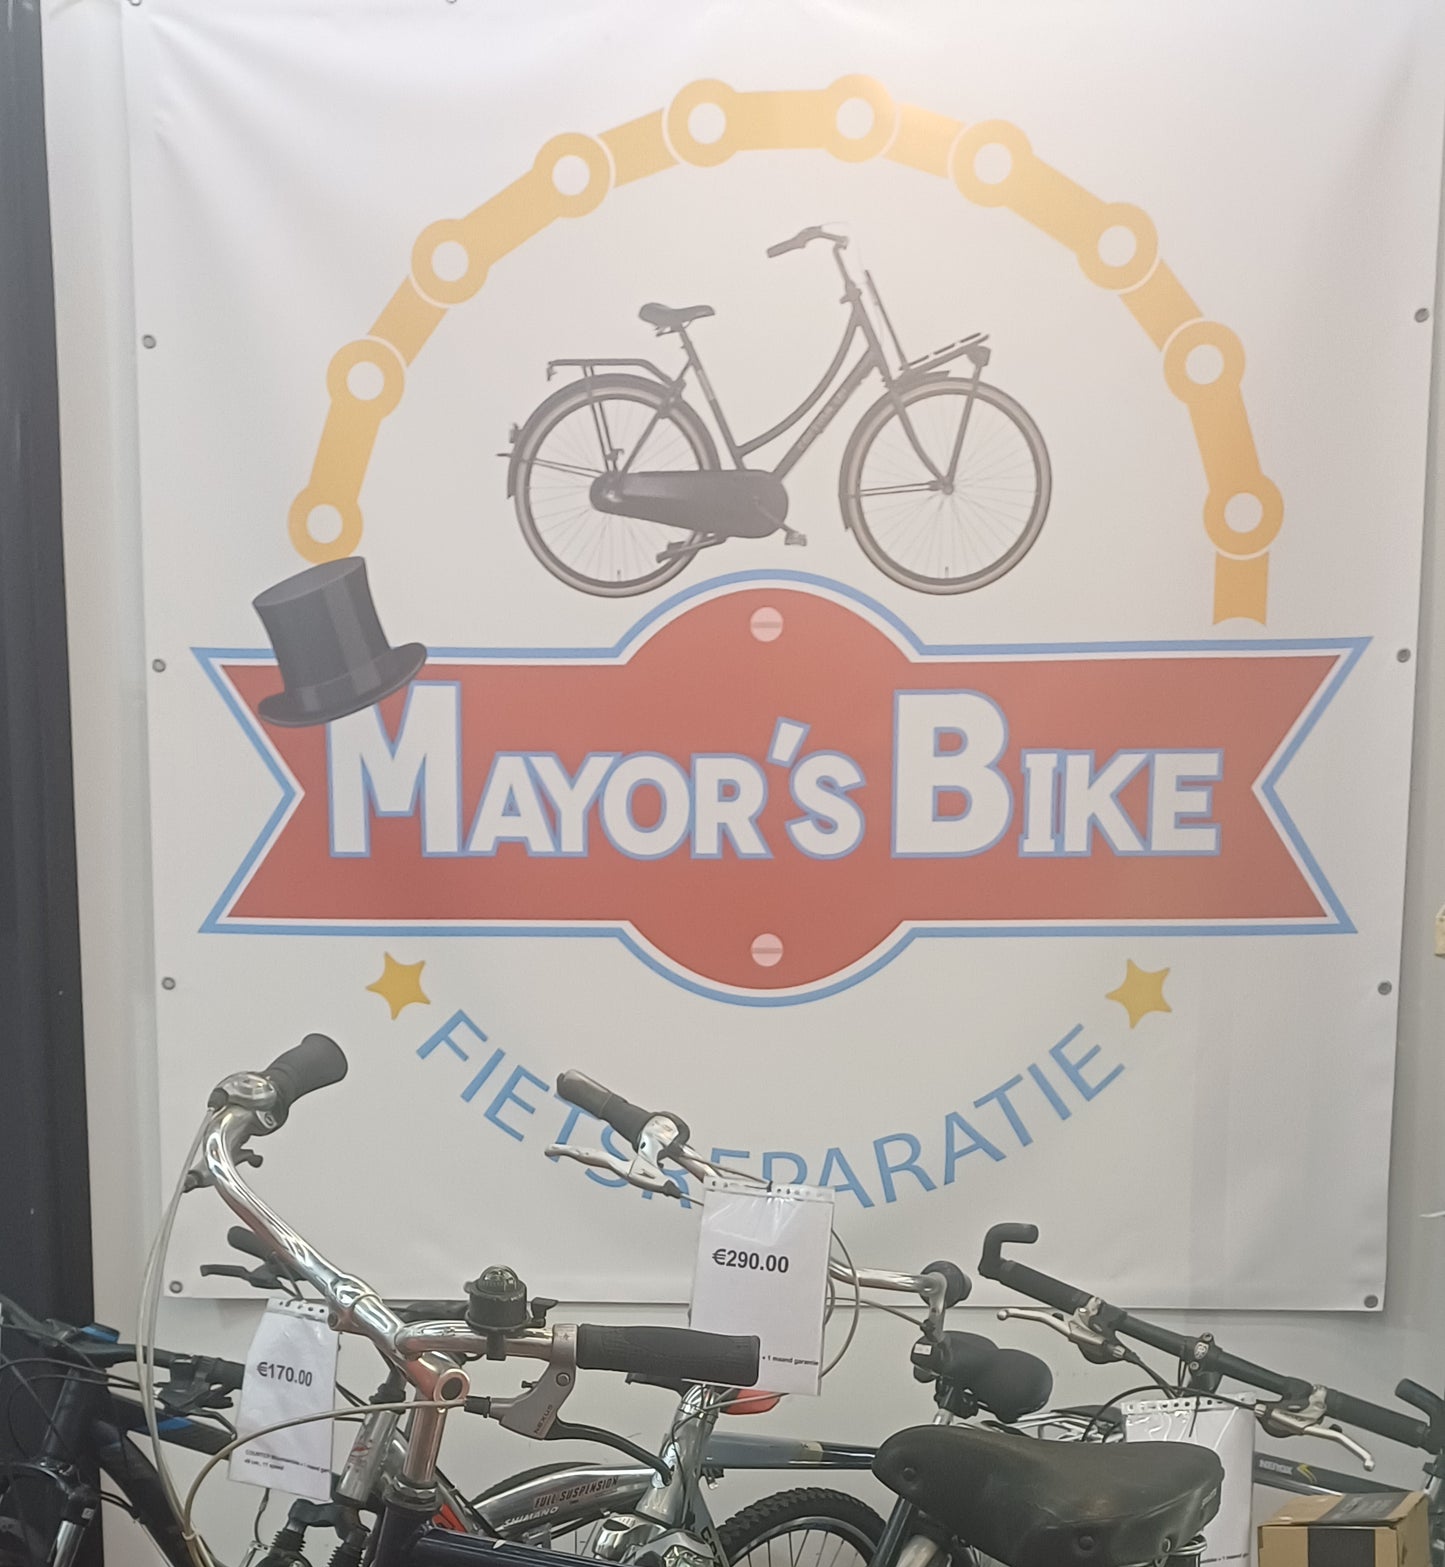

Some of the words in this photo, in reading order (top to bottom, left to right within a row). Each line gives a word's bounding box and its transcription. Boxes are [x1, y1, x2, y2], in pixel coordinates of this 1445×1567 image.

[326, 681, 865, 860] MAYOR'S
[892, 688, 1225, 859] BIKE
[711, 1248, 790, 1274] €290.00
[256, 1361, 313, 1387] €170.00
[504, 1506, 560, 1527] SHIMANO
